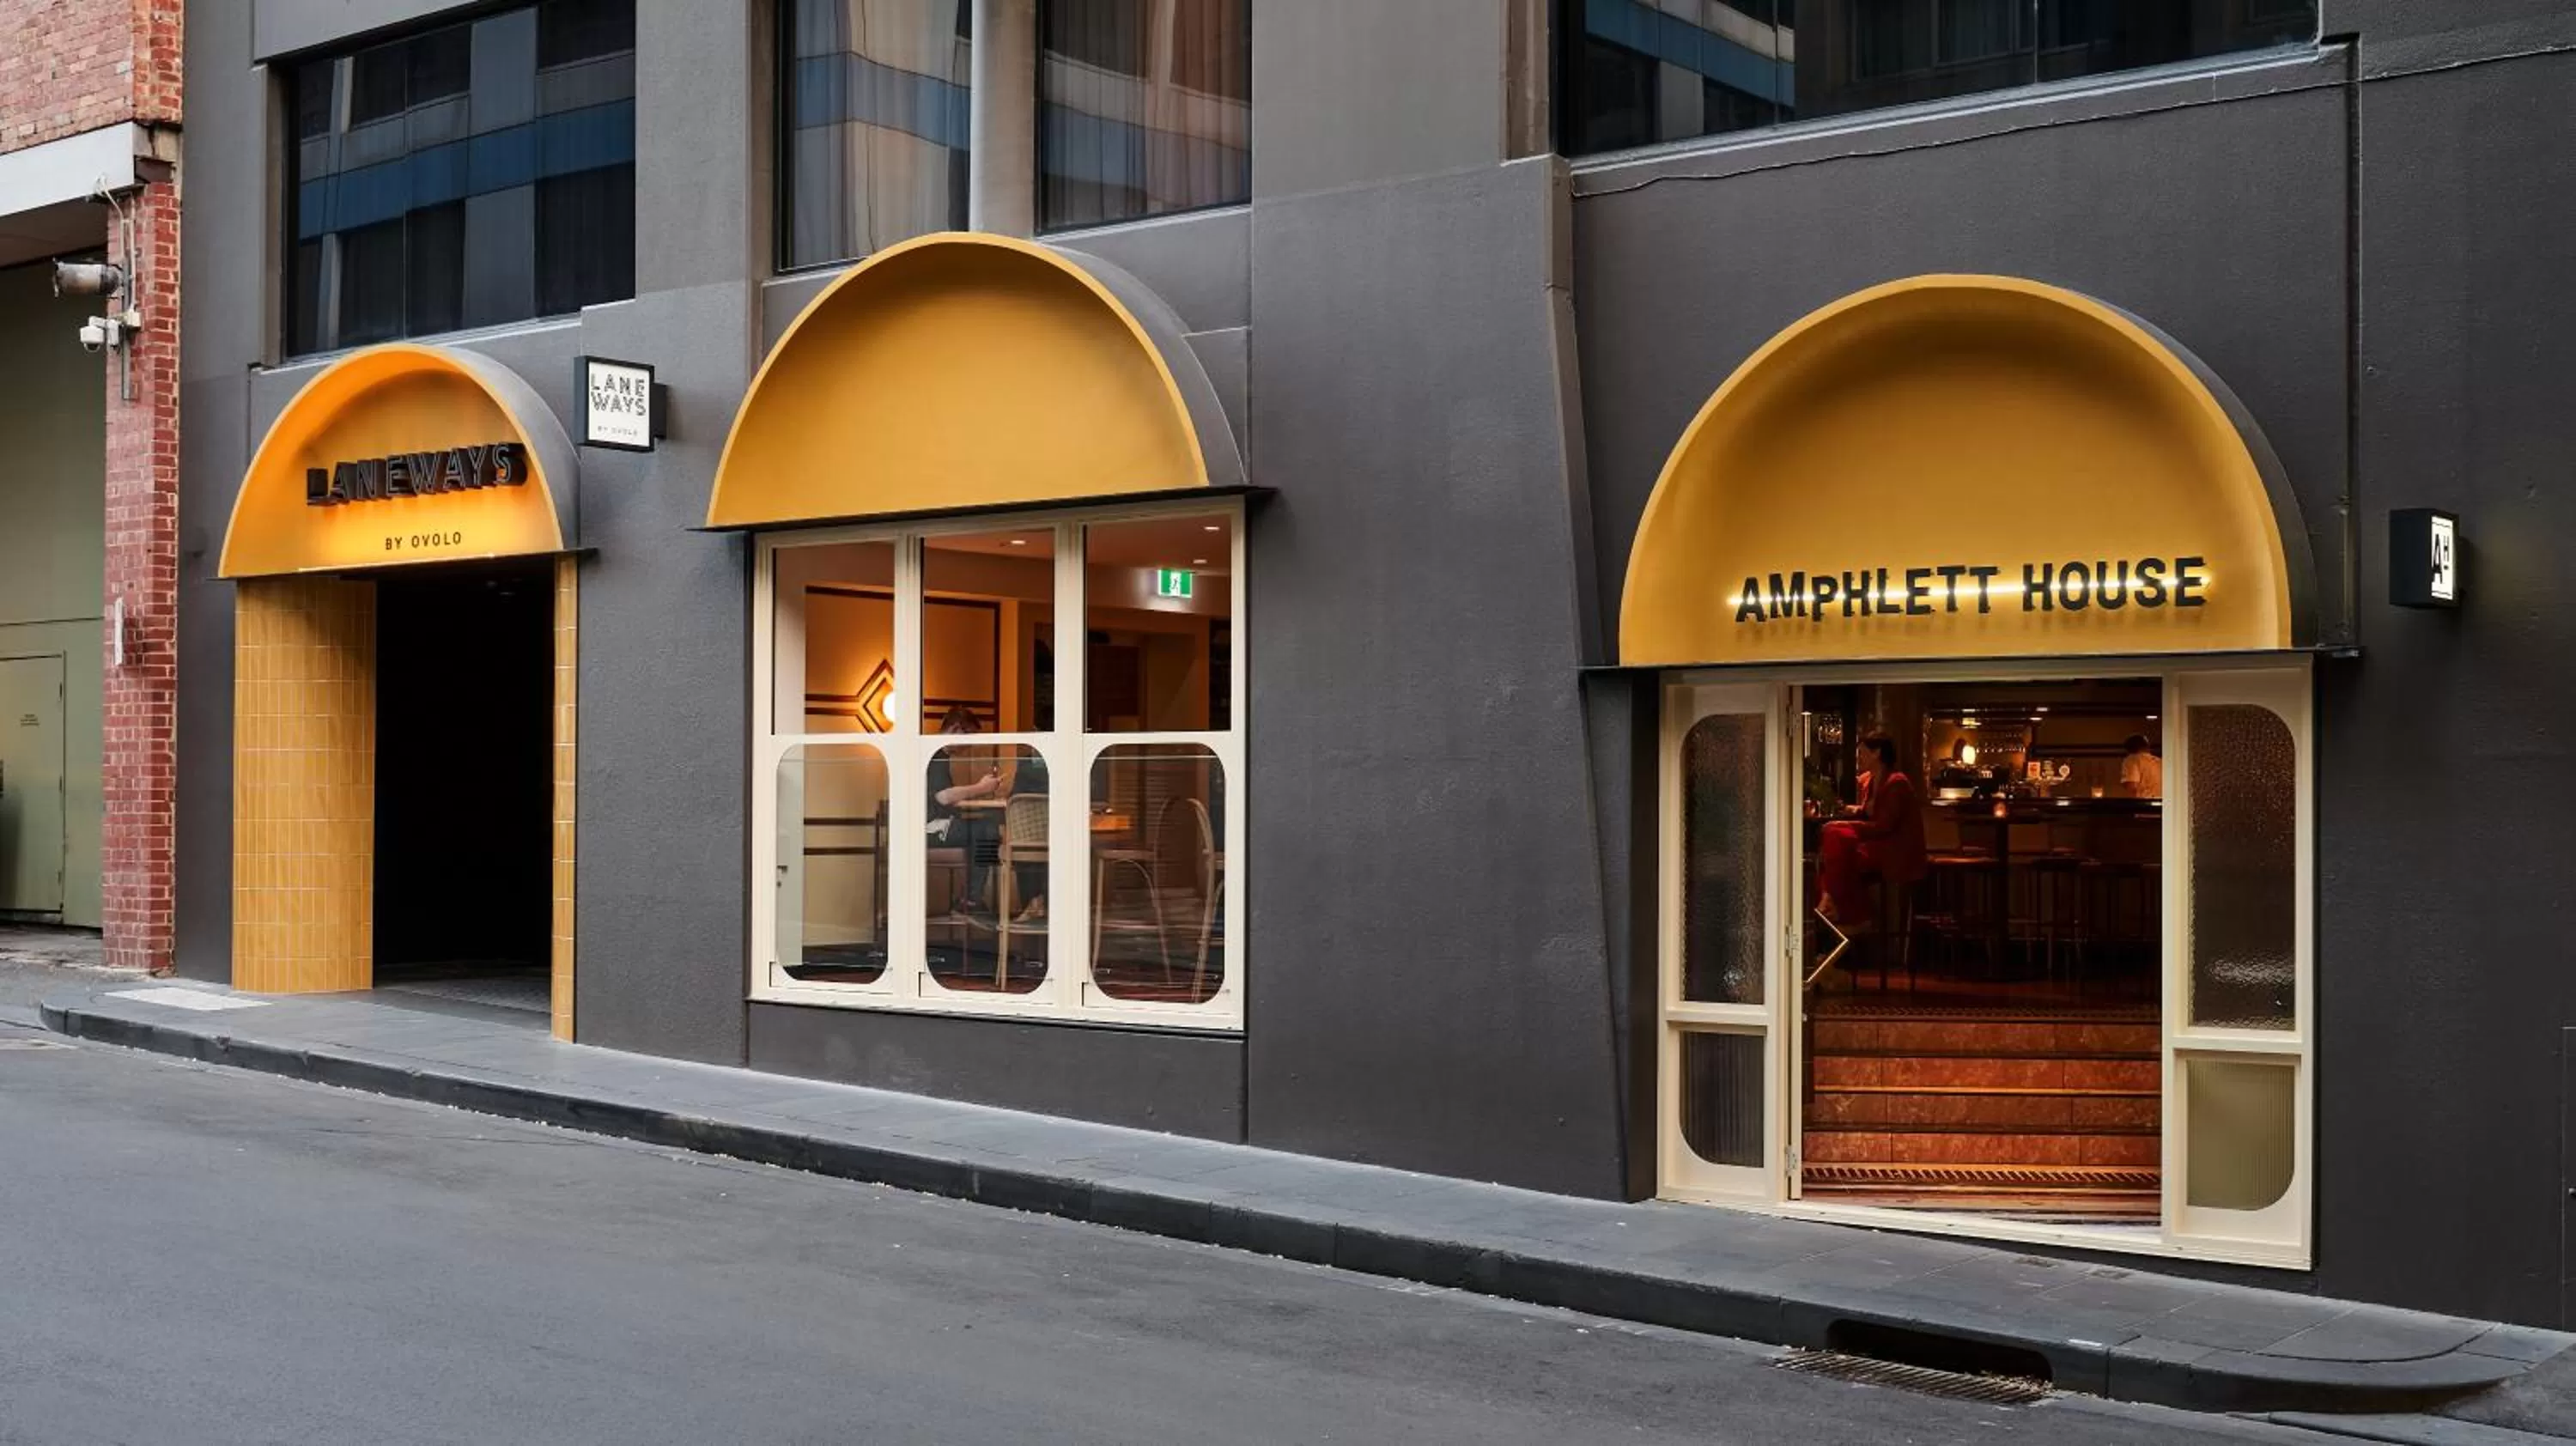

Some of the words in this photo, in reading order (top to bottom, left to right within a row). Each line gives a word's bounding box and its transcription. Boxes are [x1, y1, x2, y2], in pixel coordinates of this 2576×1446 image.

[591, 374, 645, 397] LANE
[591, 392, 647, 416] WAYS
[306, 443, 527, 507] LANEWAYS
[386, 537, 403, 550] BY
[411, 532, 462, 549] OVOLO
[1735, 566, 1999, 623] AMPHLETT
[2022, 556, 2205, 612] HOUSE
